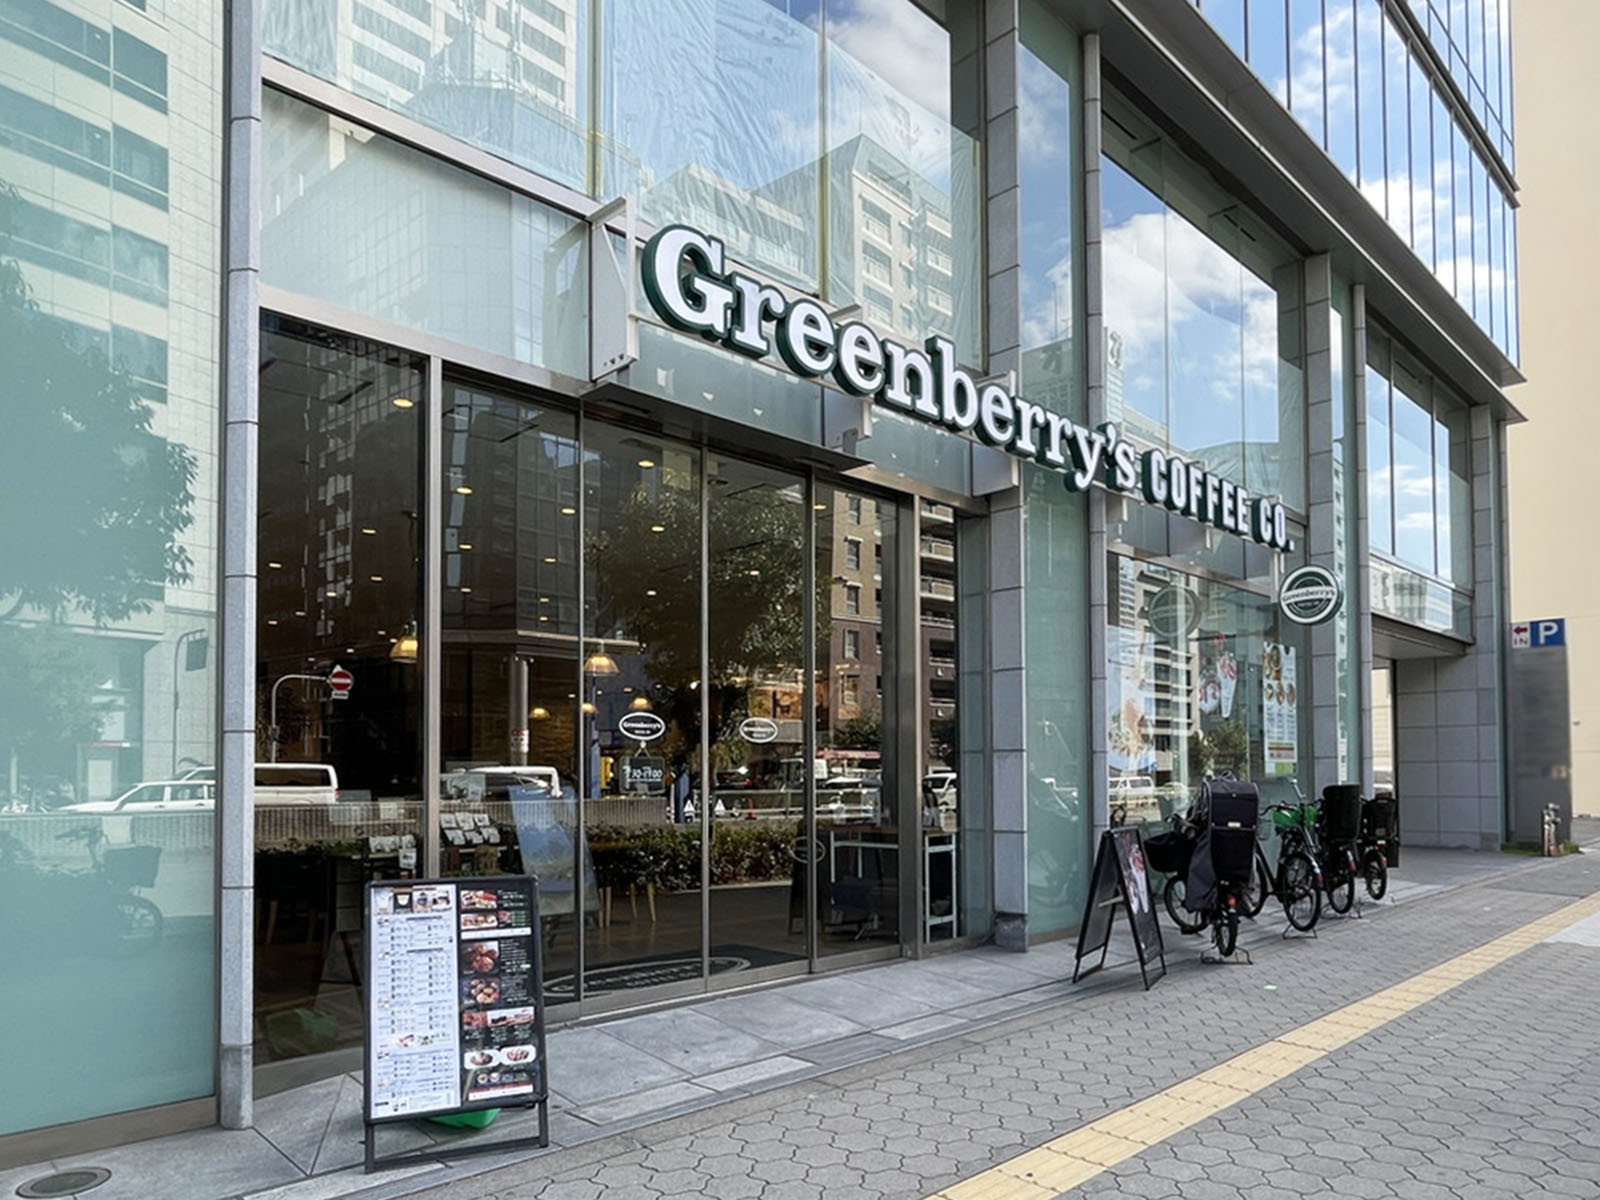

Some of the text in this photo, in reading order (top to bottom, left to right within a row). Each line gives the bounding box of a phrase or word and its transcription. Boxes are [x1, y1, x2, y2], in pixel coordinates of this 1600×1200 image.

[642, 224, 1295, 552] Greenberry's COFFEE CO.
[1539, 621, 1559, 645] P
